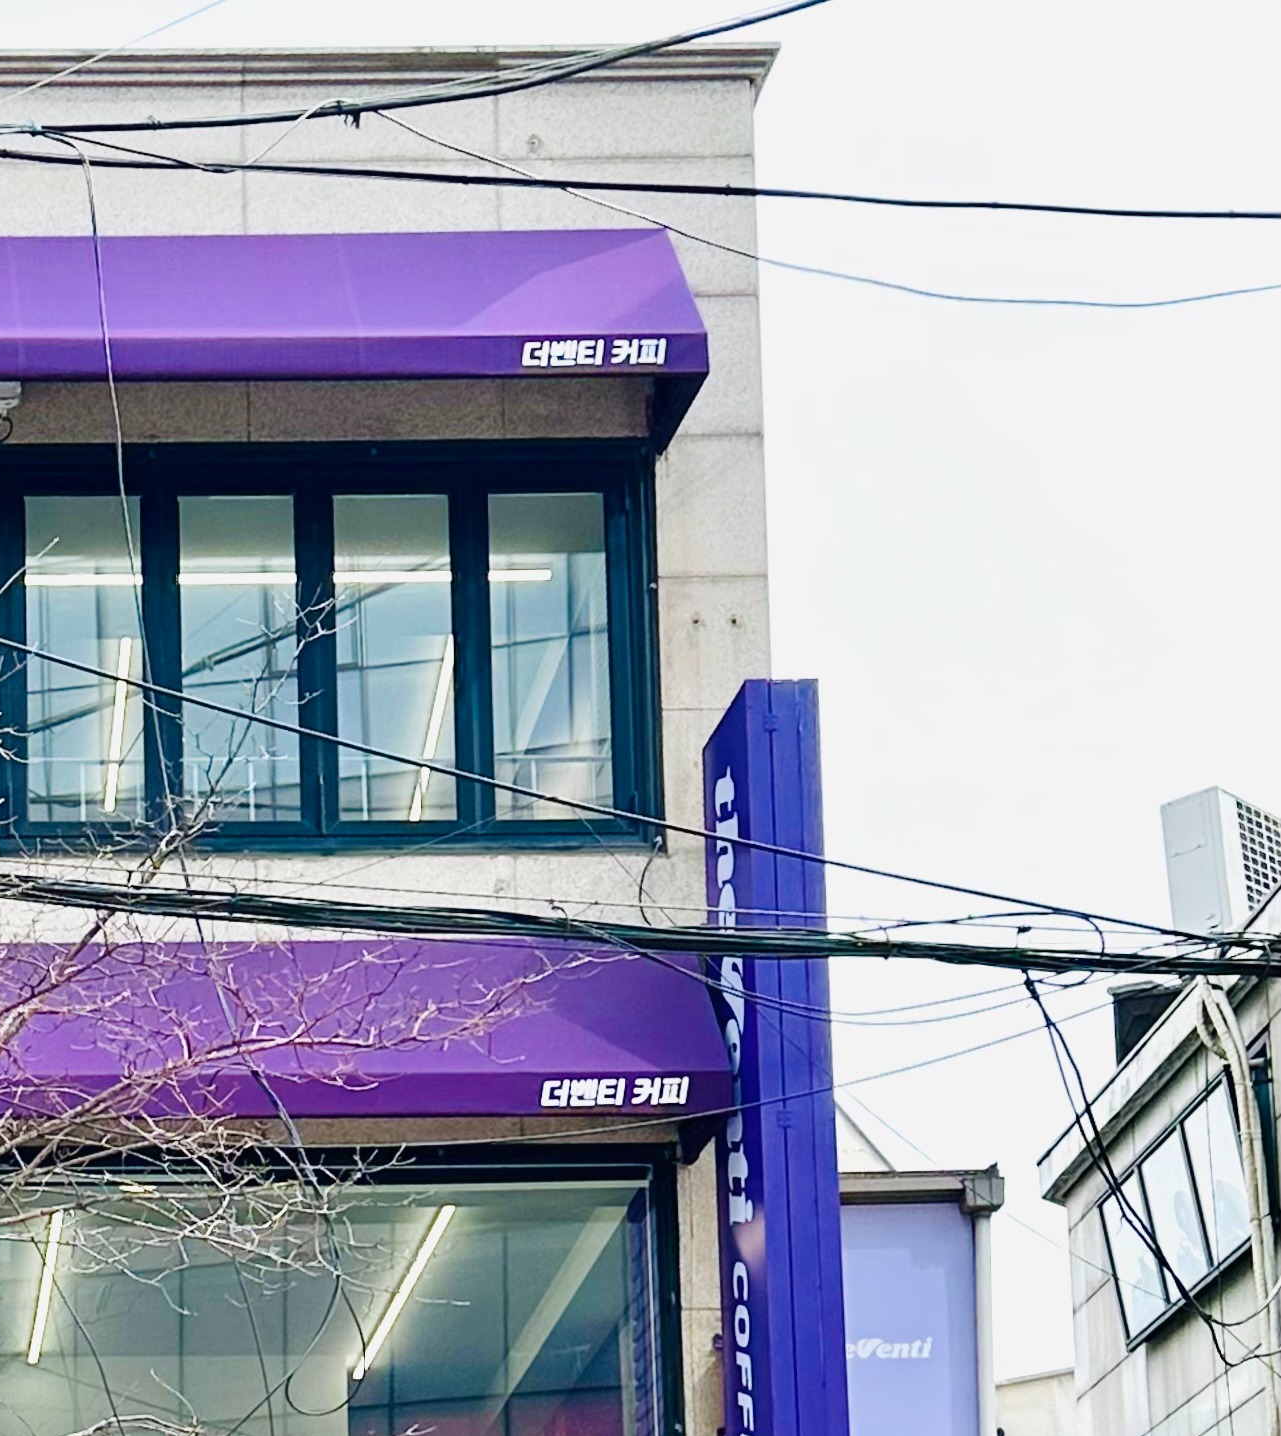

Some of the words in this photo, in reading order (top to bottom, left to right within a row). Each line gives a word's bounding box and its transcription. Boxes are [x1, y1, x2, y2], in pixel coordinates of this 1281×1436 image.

[521, 338, 605, 367] 더벤티
[610, 337, 667, 365] 커피
[540, 1077, 626, 1107] 더벤티
[631, 1076, 690, 1105] 커피
